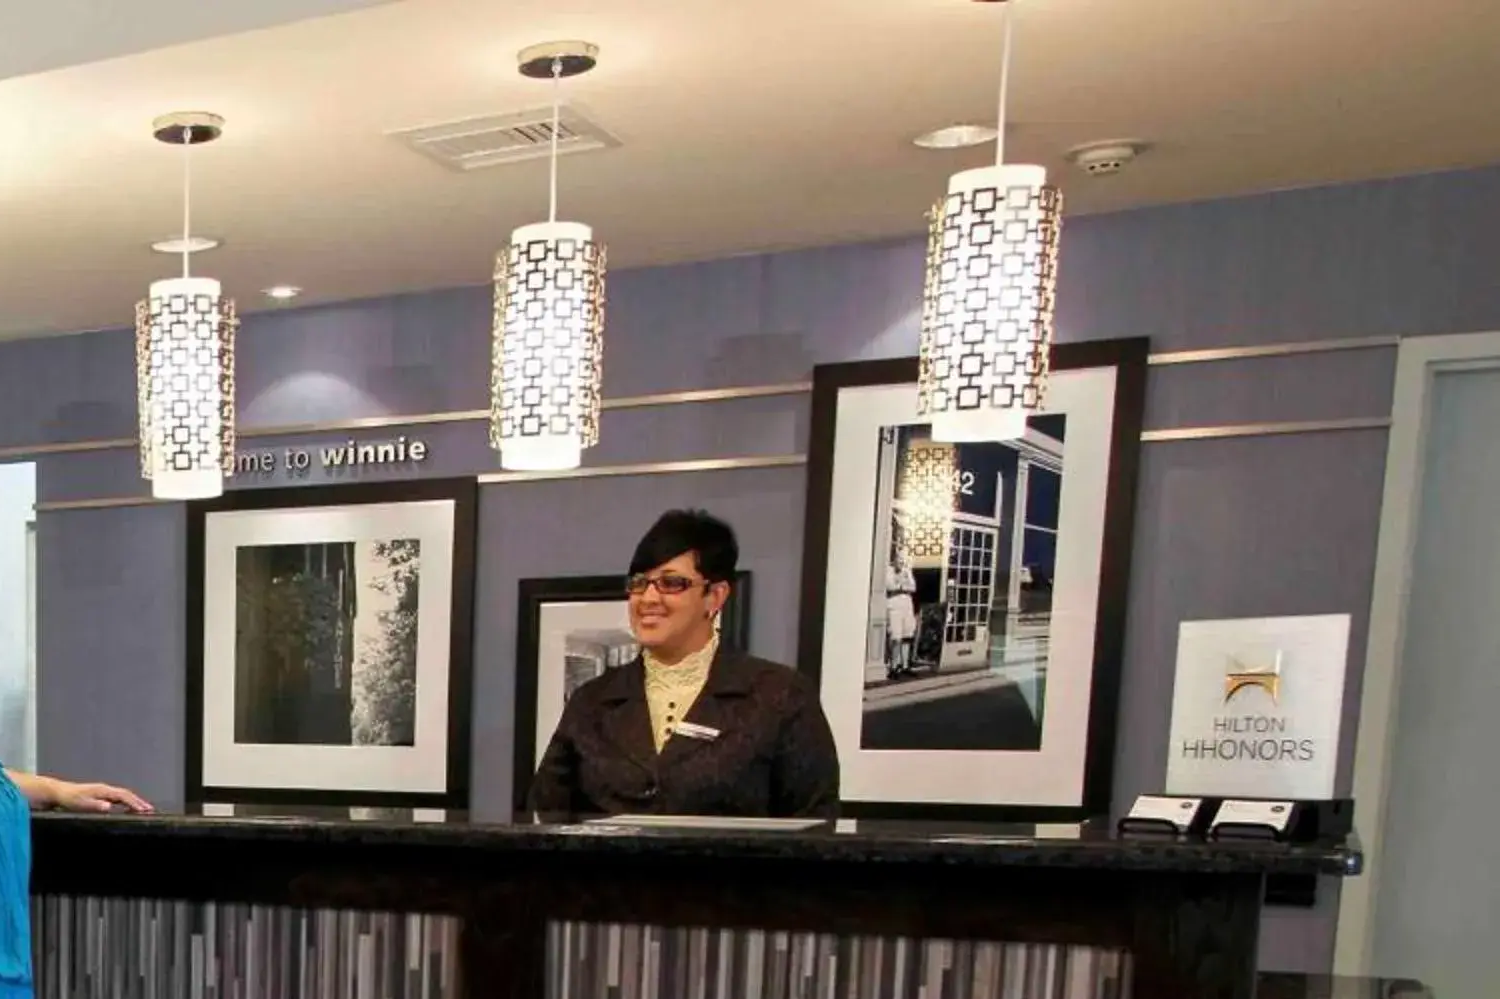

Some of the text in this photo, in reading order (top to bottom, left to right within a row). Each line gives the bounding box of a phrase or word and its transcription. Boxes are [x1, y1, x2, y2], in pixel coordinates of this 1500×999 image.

[234, 436, 425, 472] me to winnie
[1214, 716, 1285, 732] HILTON
[1182, 739, 1314, 760] HHONORS
